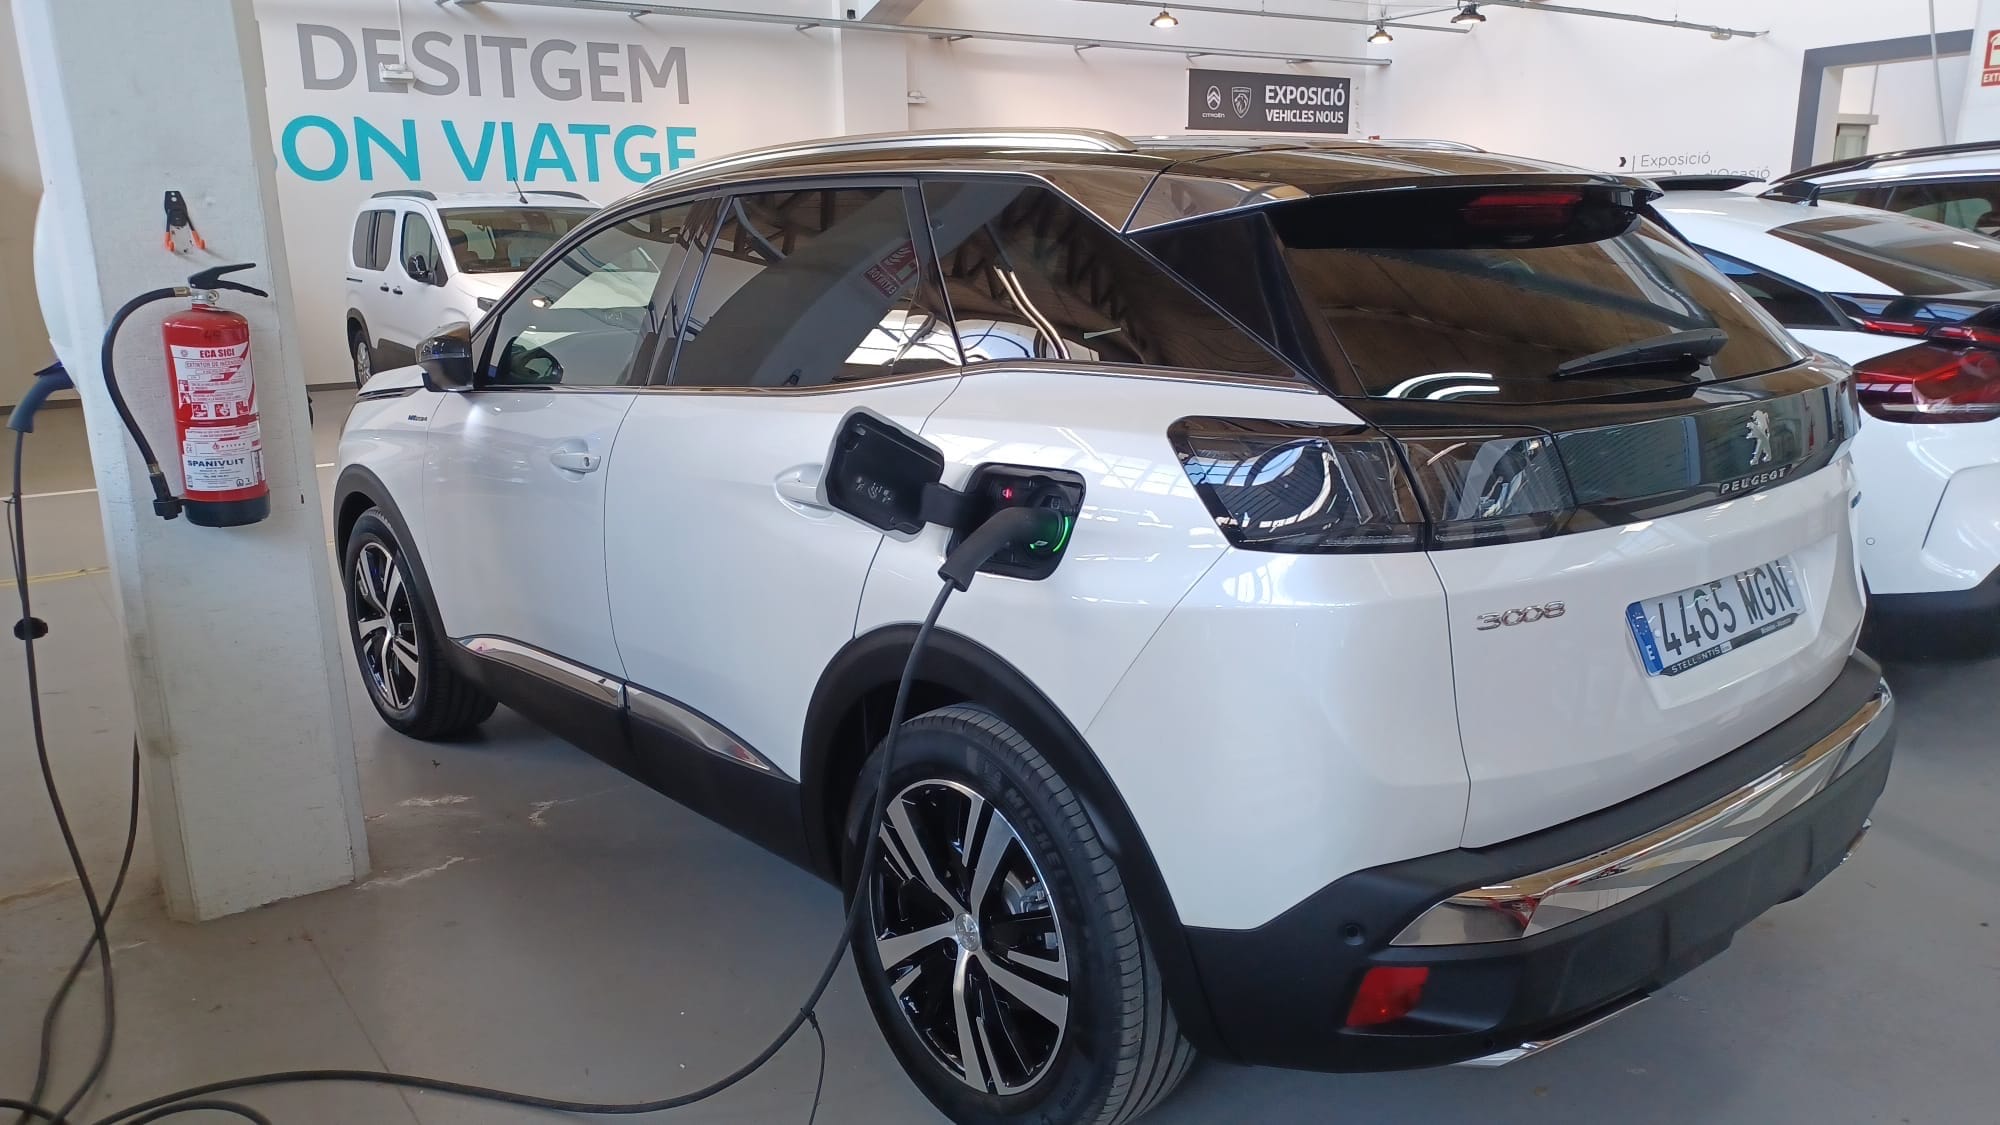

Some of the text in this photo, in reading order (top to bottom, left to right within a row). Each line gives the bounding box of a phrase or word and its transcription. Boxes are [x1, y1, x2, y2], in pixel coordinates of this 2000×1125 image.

[296, 23, 690, 105] DESITGEM
[1265, 83, 1345, 106] EXPOSICIÓ
[1265, 109, 1344, 124] VEHICLES NOUS
[273, 114, 697, 184] ON VIATGE
[1640, 151, 1711, 168] Exposició
[200, 349, 217, 358] ECA
[1721, 467, 1786, 494] PEUGEOT
[1476, 600, 1566, 631] 3008
[1658, 560, 1795, 656] 4465 MGN
[1004, 786, 1078, 908] MICHEL
